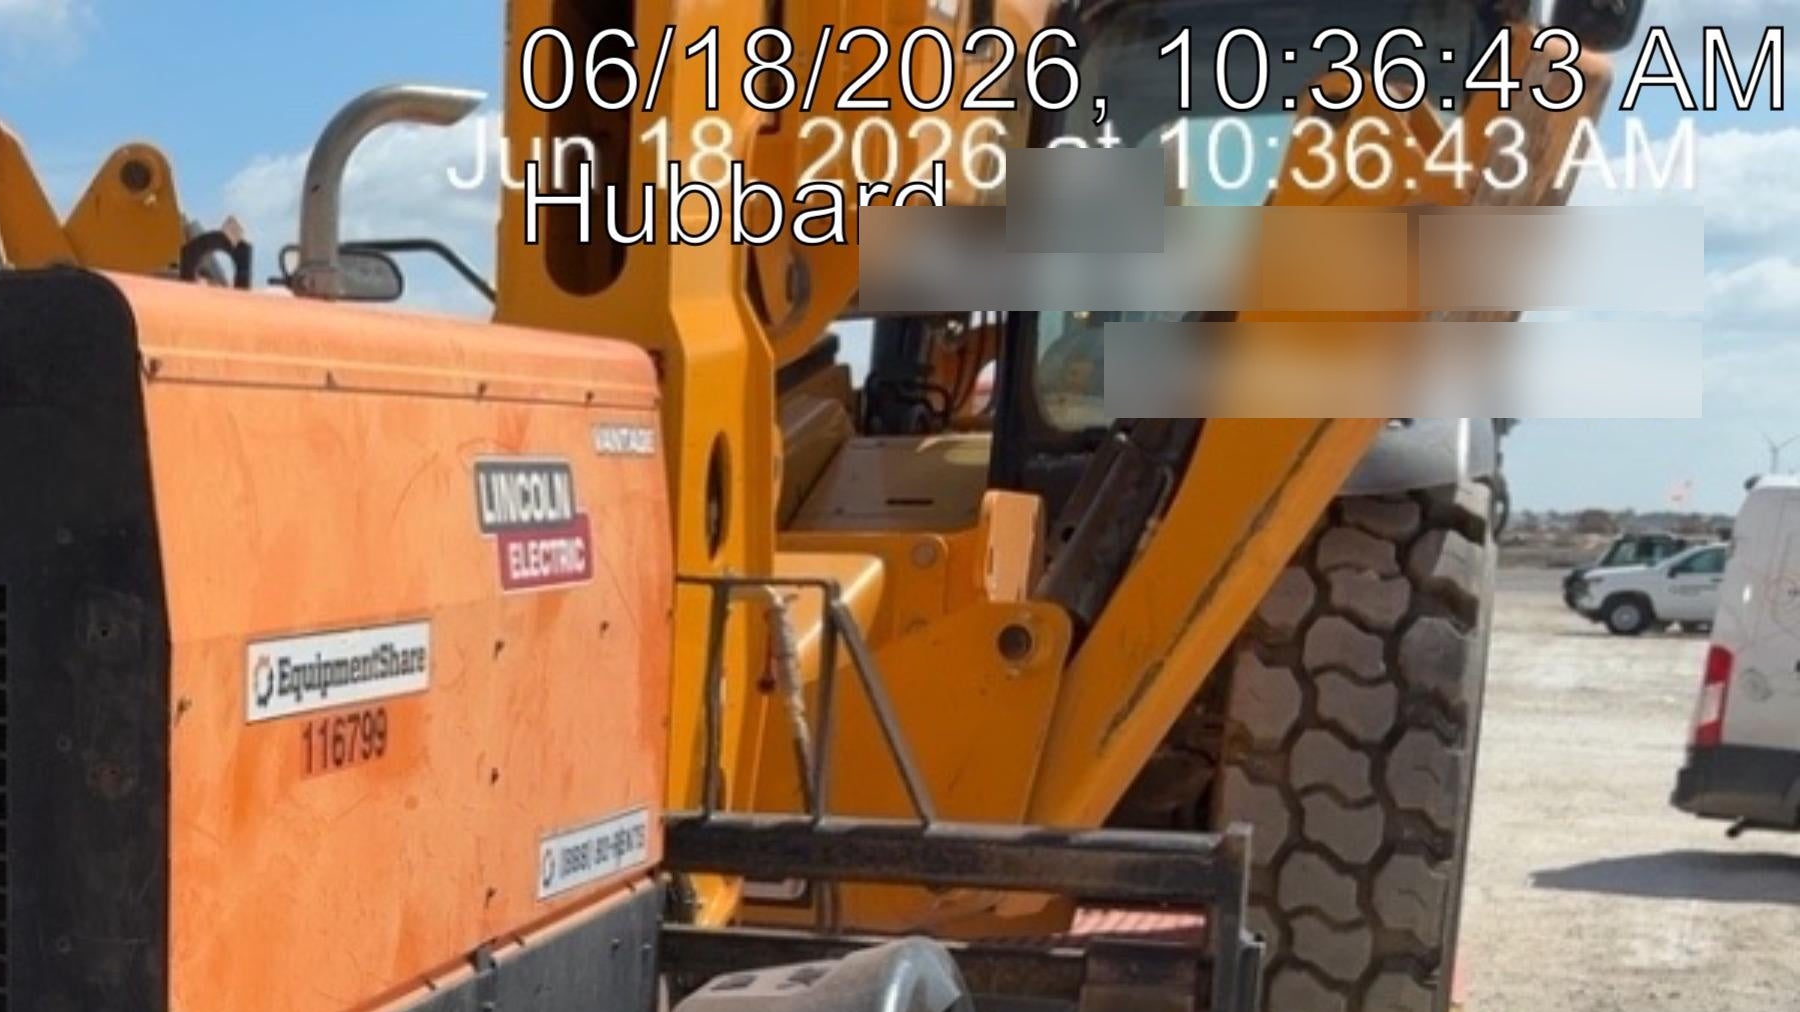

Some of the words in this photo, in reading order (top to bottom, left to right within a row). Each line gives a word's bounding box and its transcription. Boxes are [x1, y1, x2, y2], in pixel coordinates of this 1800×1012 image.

[479, 470, 573, 524] LINCOLN
[508, 536, 587, 580] ELECTRIC
[277, 642, 426, 702] EquipmentShare
[303, 706, 388, 774] 116799
